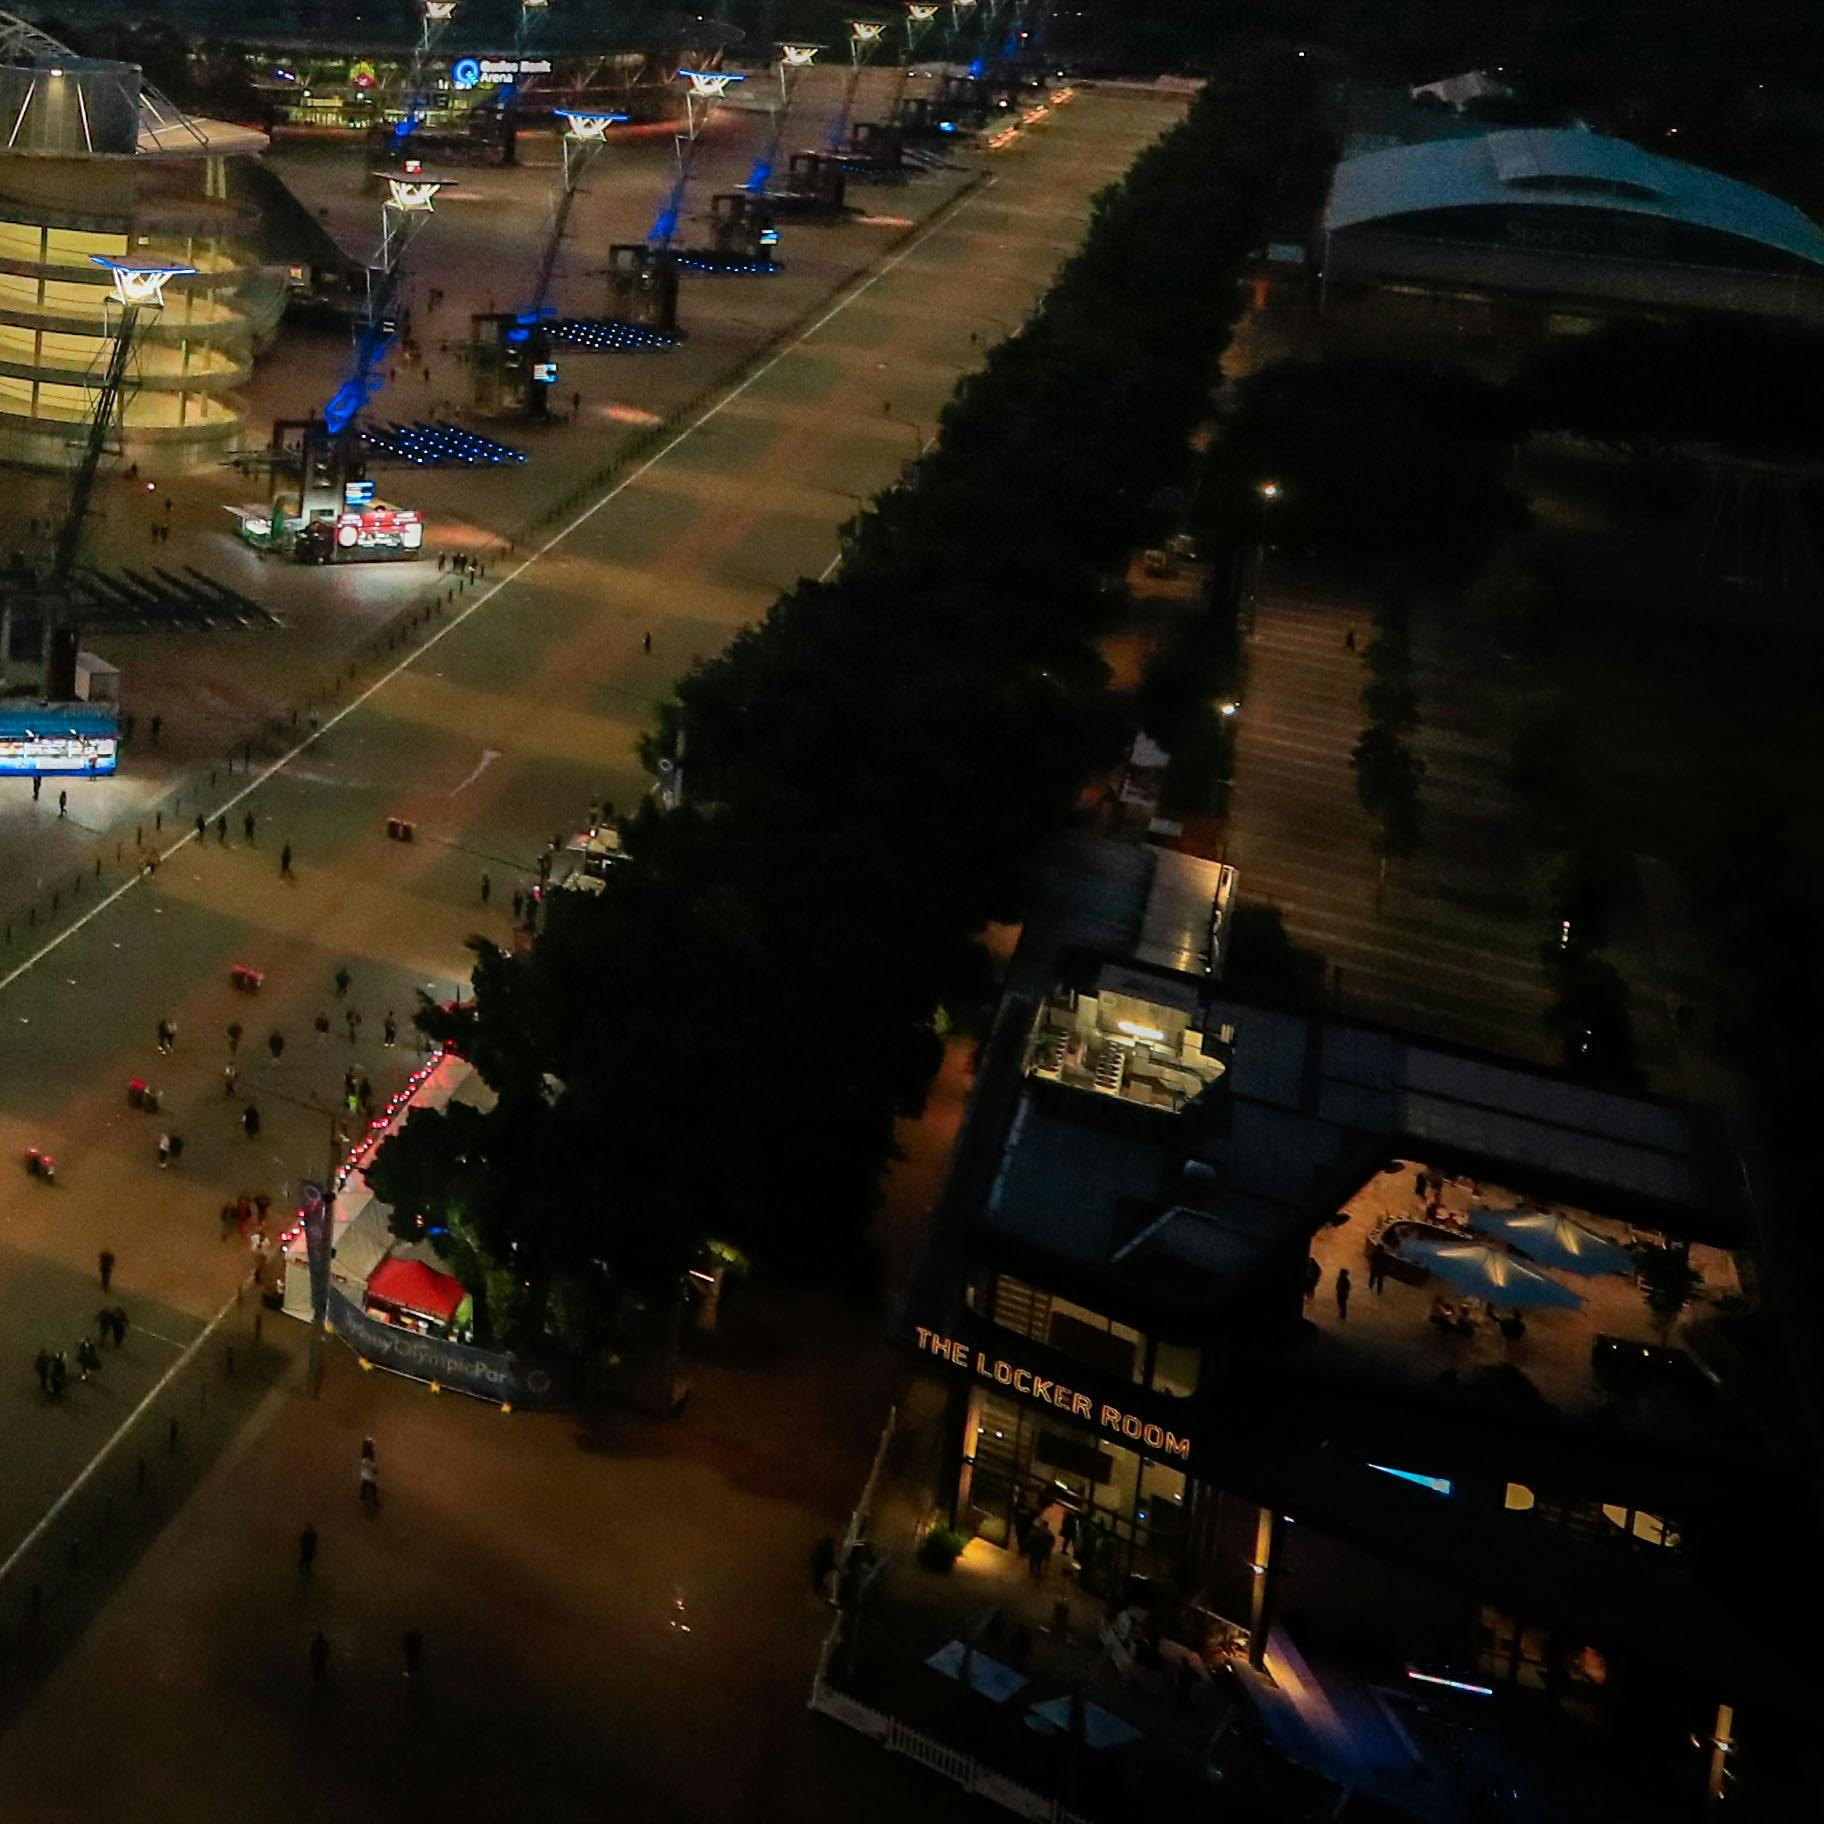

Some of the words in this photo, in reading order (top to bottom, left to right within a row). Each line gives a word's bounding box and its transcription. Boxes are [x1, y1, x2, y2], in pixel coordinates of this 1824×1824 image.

[915, 1326, 970, 1368] THE
[976, 1352, 1094, 1421] LOCKER
[1100, 1404, 1192, 1461] ROOM
